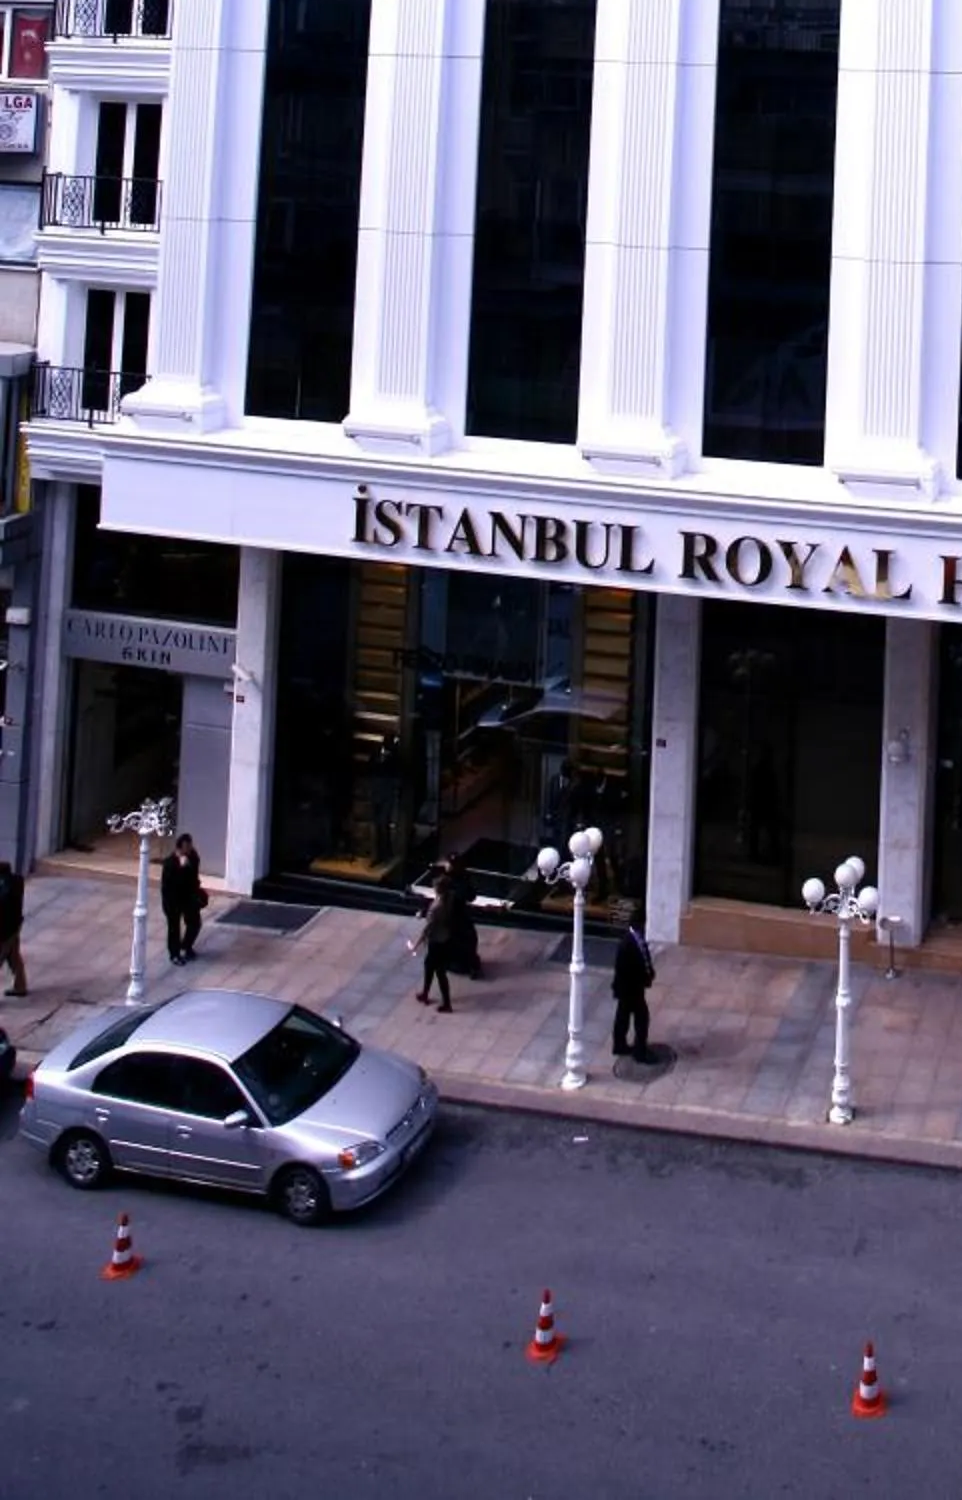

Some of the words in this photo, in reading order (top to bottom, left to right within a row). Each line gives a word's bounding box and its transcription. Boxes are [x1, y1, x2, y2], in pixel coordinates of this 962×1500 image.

[352, 484, 655, 575] İSTANBUL
[678, 530, 912, 600] ROYAL
[67, 617, 133, 643] CARLO
